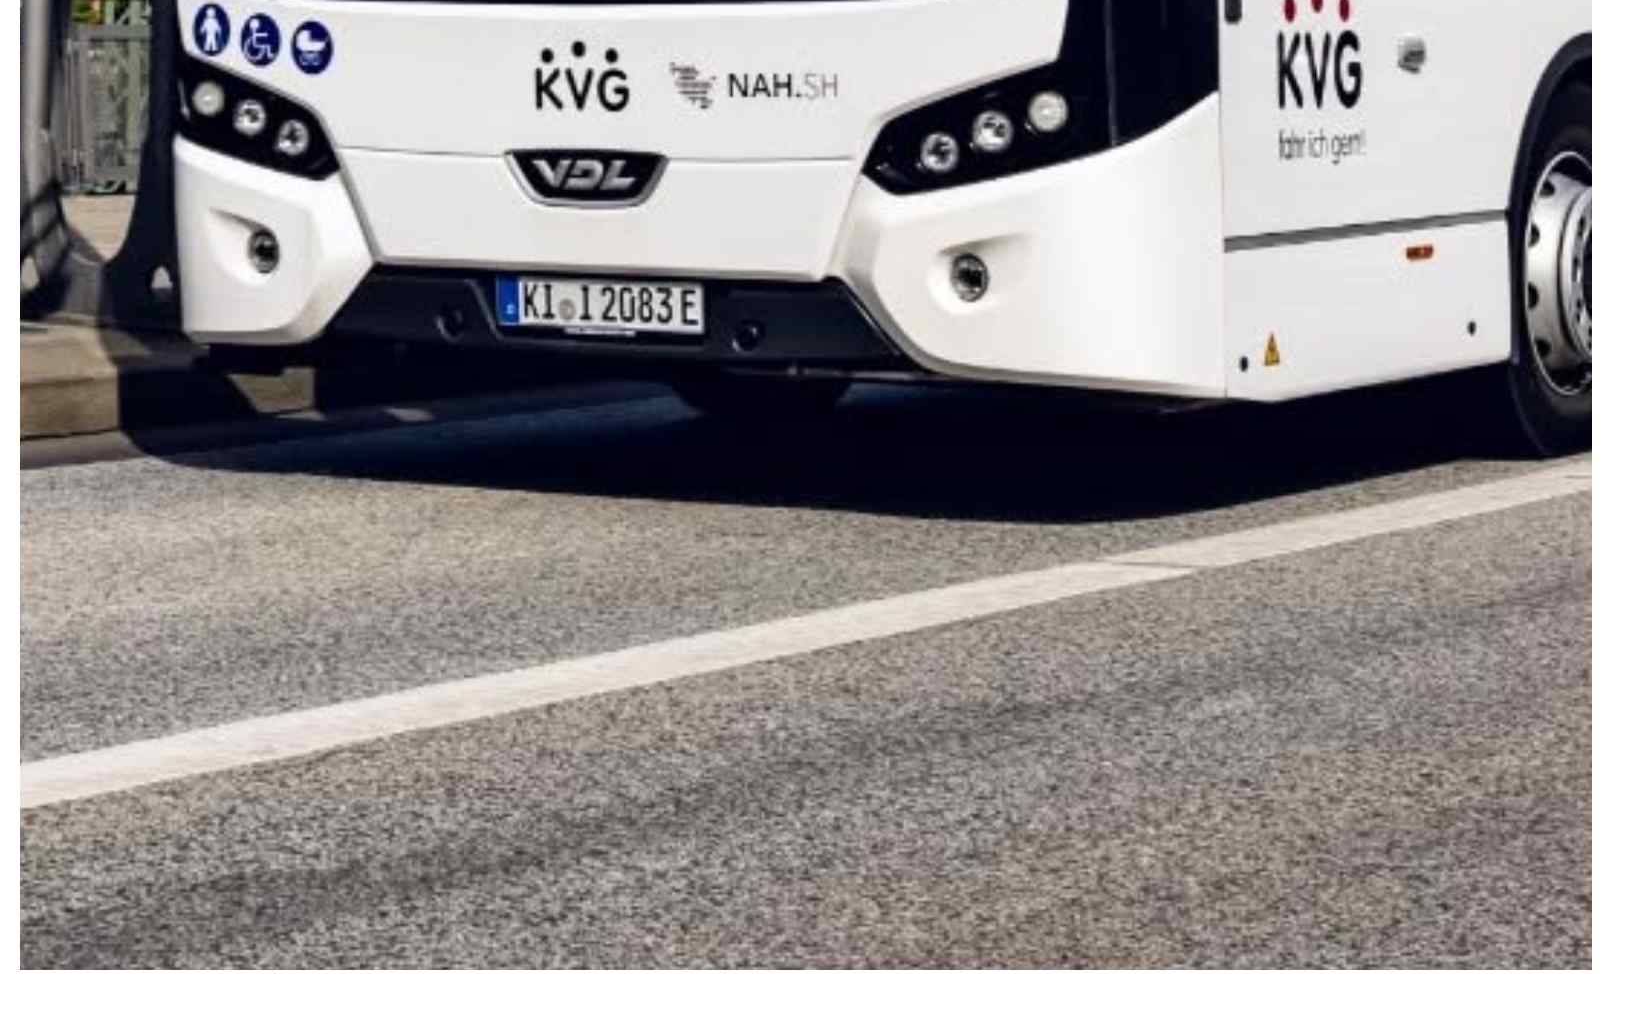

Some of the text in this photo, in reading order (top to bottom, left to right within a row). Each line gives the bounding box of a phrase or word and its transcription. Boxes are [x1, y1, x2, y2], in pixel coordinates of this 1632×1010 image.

[727, 73, 839, 99] NAH.SH
[1277, 29, 1363, 109] KVG
[534, 66, 631, 113] KVG
[532, 159, 637, 190] VDL
[524, 284, 556, 320] KI
